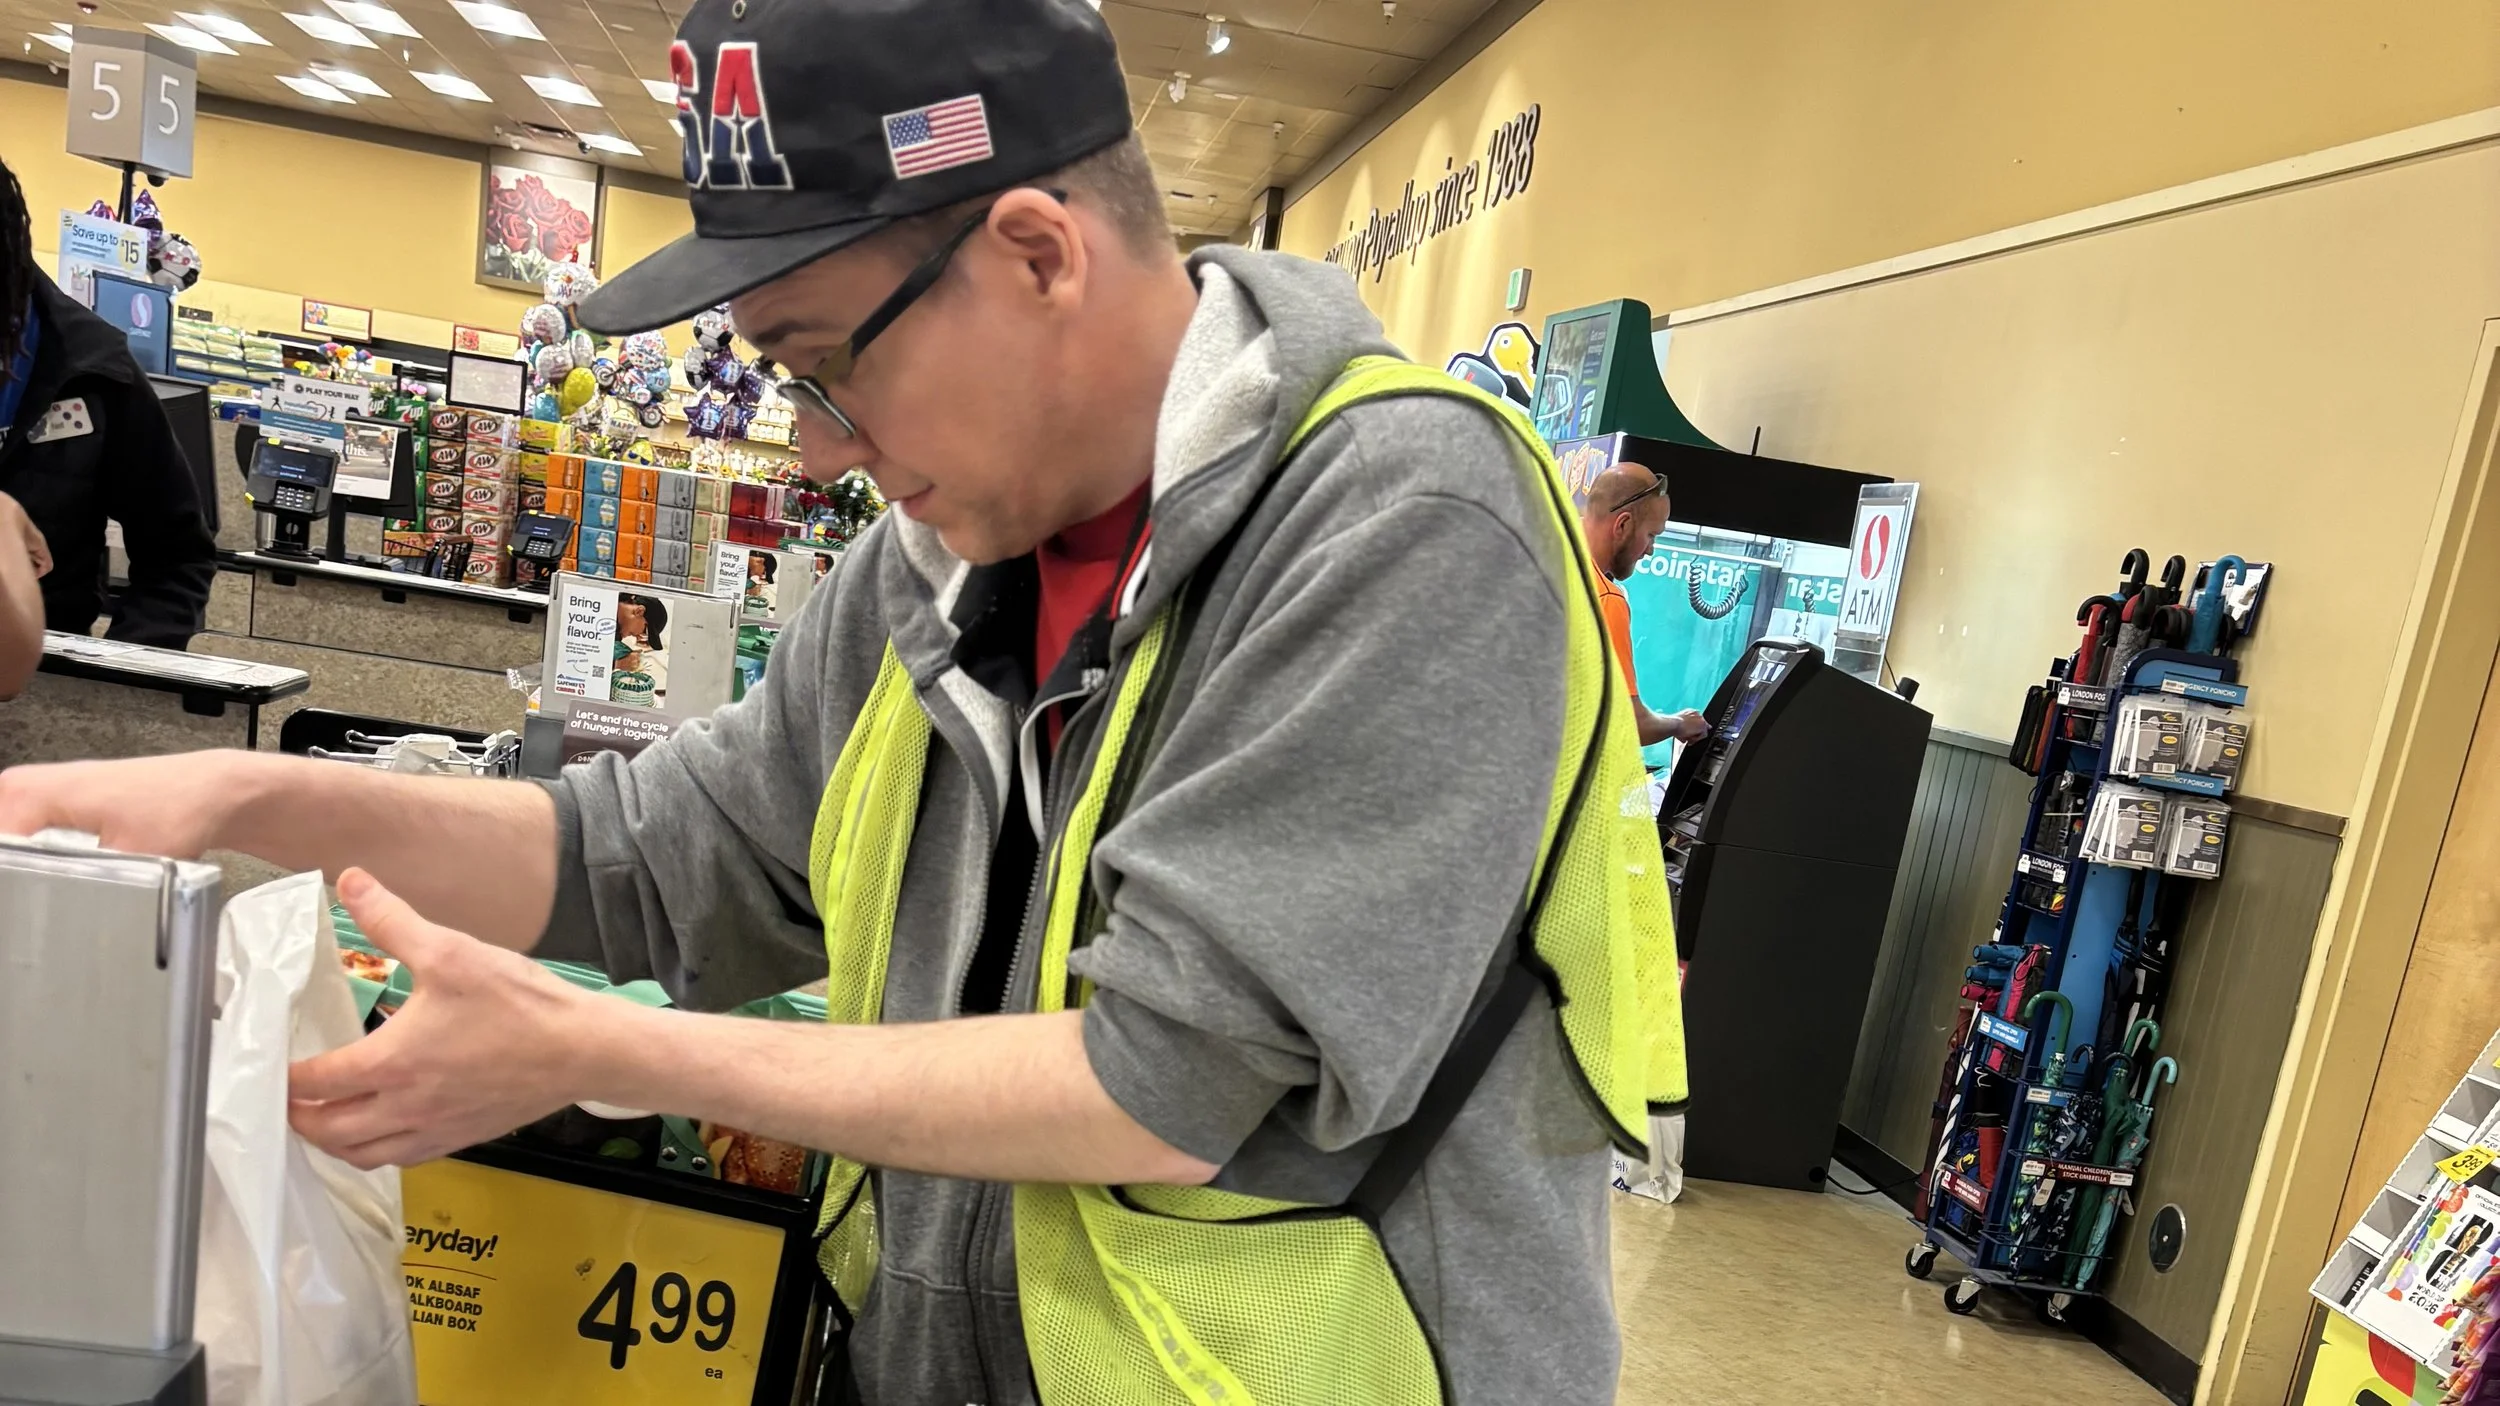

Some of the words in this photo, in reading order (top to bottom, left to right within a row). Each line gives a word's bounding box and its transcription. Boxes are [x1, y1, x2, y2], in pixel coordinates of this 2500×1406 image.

[91, 61, 121, 121] 5
[158, 74, 180, 135] 5
[1363, 179, 1431, 284] Puyallup
[1429, 156, 1479, 238] since
[1482, 103, 1541, 211] 1988
[72, 224, 95, 240] Save
[96, 232, 108, 246] up
[110, 234, 119, 246] to
[305, 387, 323, 395] PLAY
[323, 389, 343, 398] YOUR
[344, 393, 359, 401] WAY
[396, 405, 424, 424] 7up
[721, 552, 740, 562] Bring
[1634, 551, 1746, 588] coinstar
[570, 595, 601, 613] Bring
[1844, 588, 1884, 626] ATM
[568, 612, 596, 624] your
[567, 625, 602, 641] flavor.
[2072, 689, 2094, 700] LONDON
[2094, 692, 2107, 702] FOG
[2209, 687, 2237, 698] PONCHO
[570, 719, 581, 728] of
[582, 721, 622, 737] hunger,
[623, 728, 670, 742] together.
[576, 709, 599, 722] Let's
[600, 714, 621, 725] end
[622, 717, 640, 728] the
[641, 721, 669, 733] cycle
[2187, 779, 2215, 789] PONCHO
[2032, 856, 2053, 869] LONDON
[2058, 1164, 2083, 1173] MANUAL
[2062, 1171, 2078, 1179] STICK
[2078, 1174, 2107, 1182] UMBRELLA
[428, 1280, 481, 1299] ALBSAF
[410, 1292, 483, 1316] ALKBOARD
[2408, 1292, 2439, 1315] 2026
[412, 1309, 444, 1326] LIAN
[447, 1315, 478, 1332] BOX
[705, 1366, 724, 1380] ea
